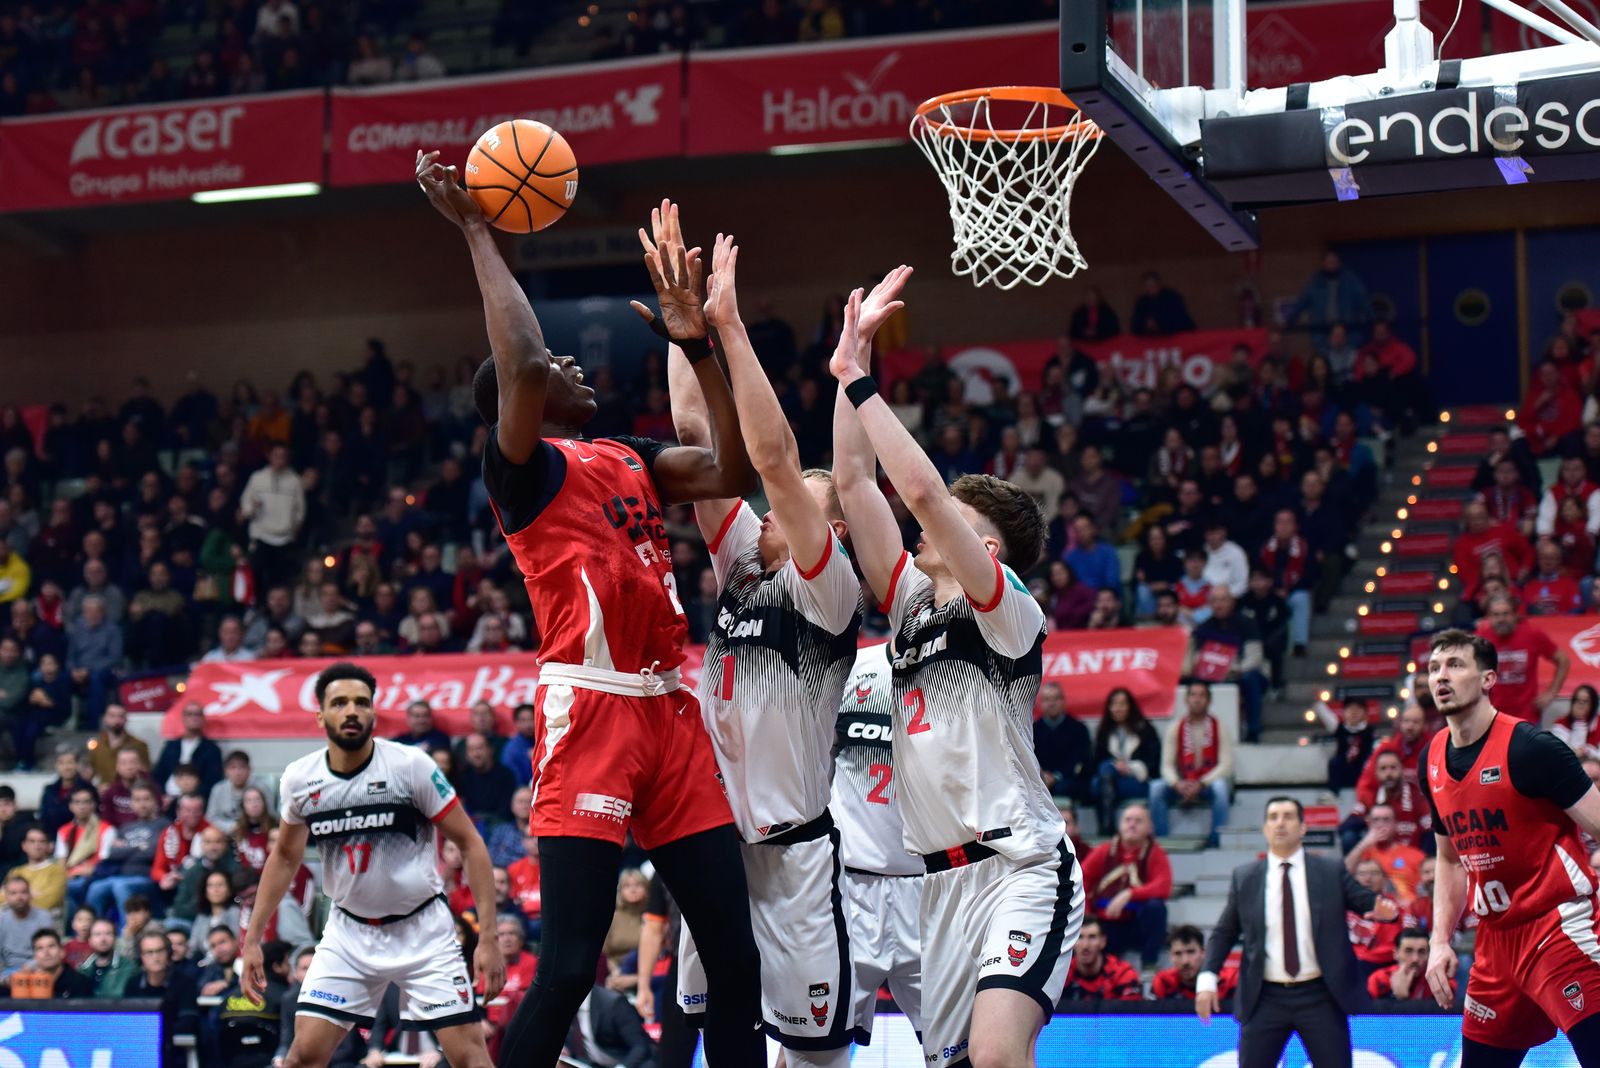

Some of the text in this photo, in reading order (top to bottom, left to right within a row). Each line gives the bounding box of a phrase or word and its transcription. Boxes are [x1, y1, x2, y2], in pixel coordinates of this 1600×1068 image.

[104, 106, 246, 160] caser
[347, 102, 613, 152] COMPRALARADA
[1009, 932, 1028, 942] acb
[810, 987, 827, 997] acb
